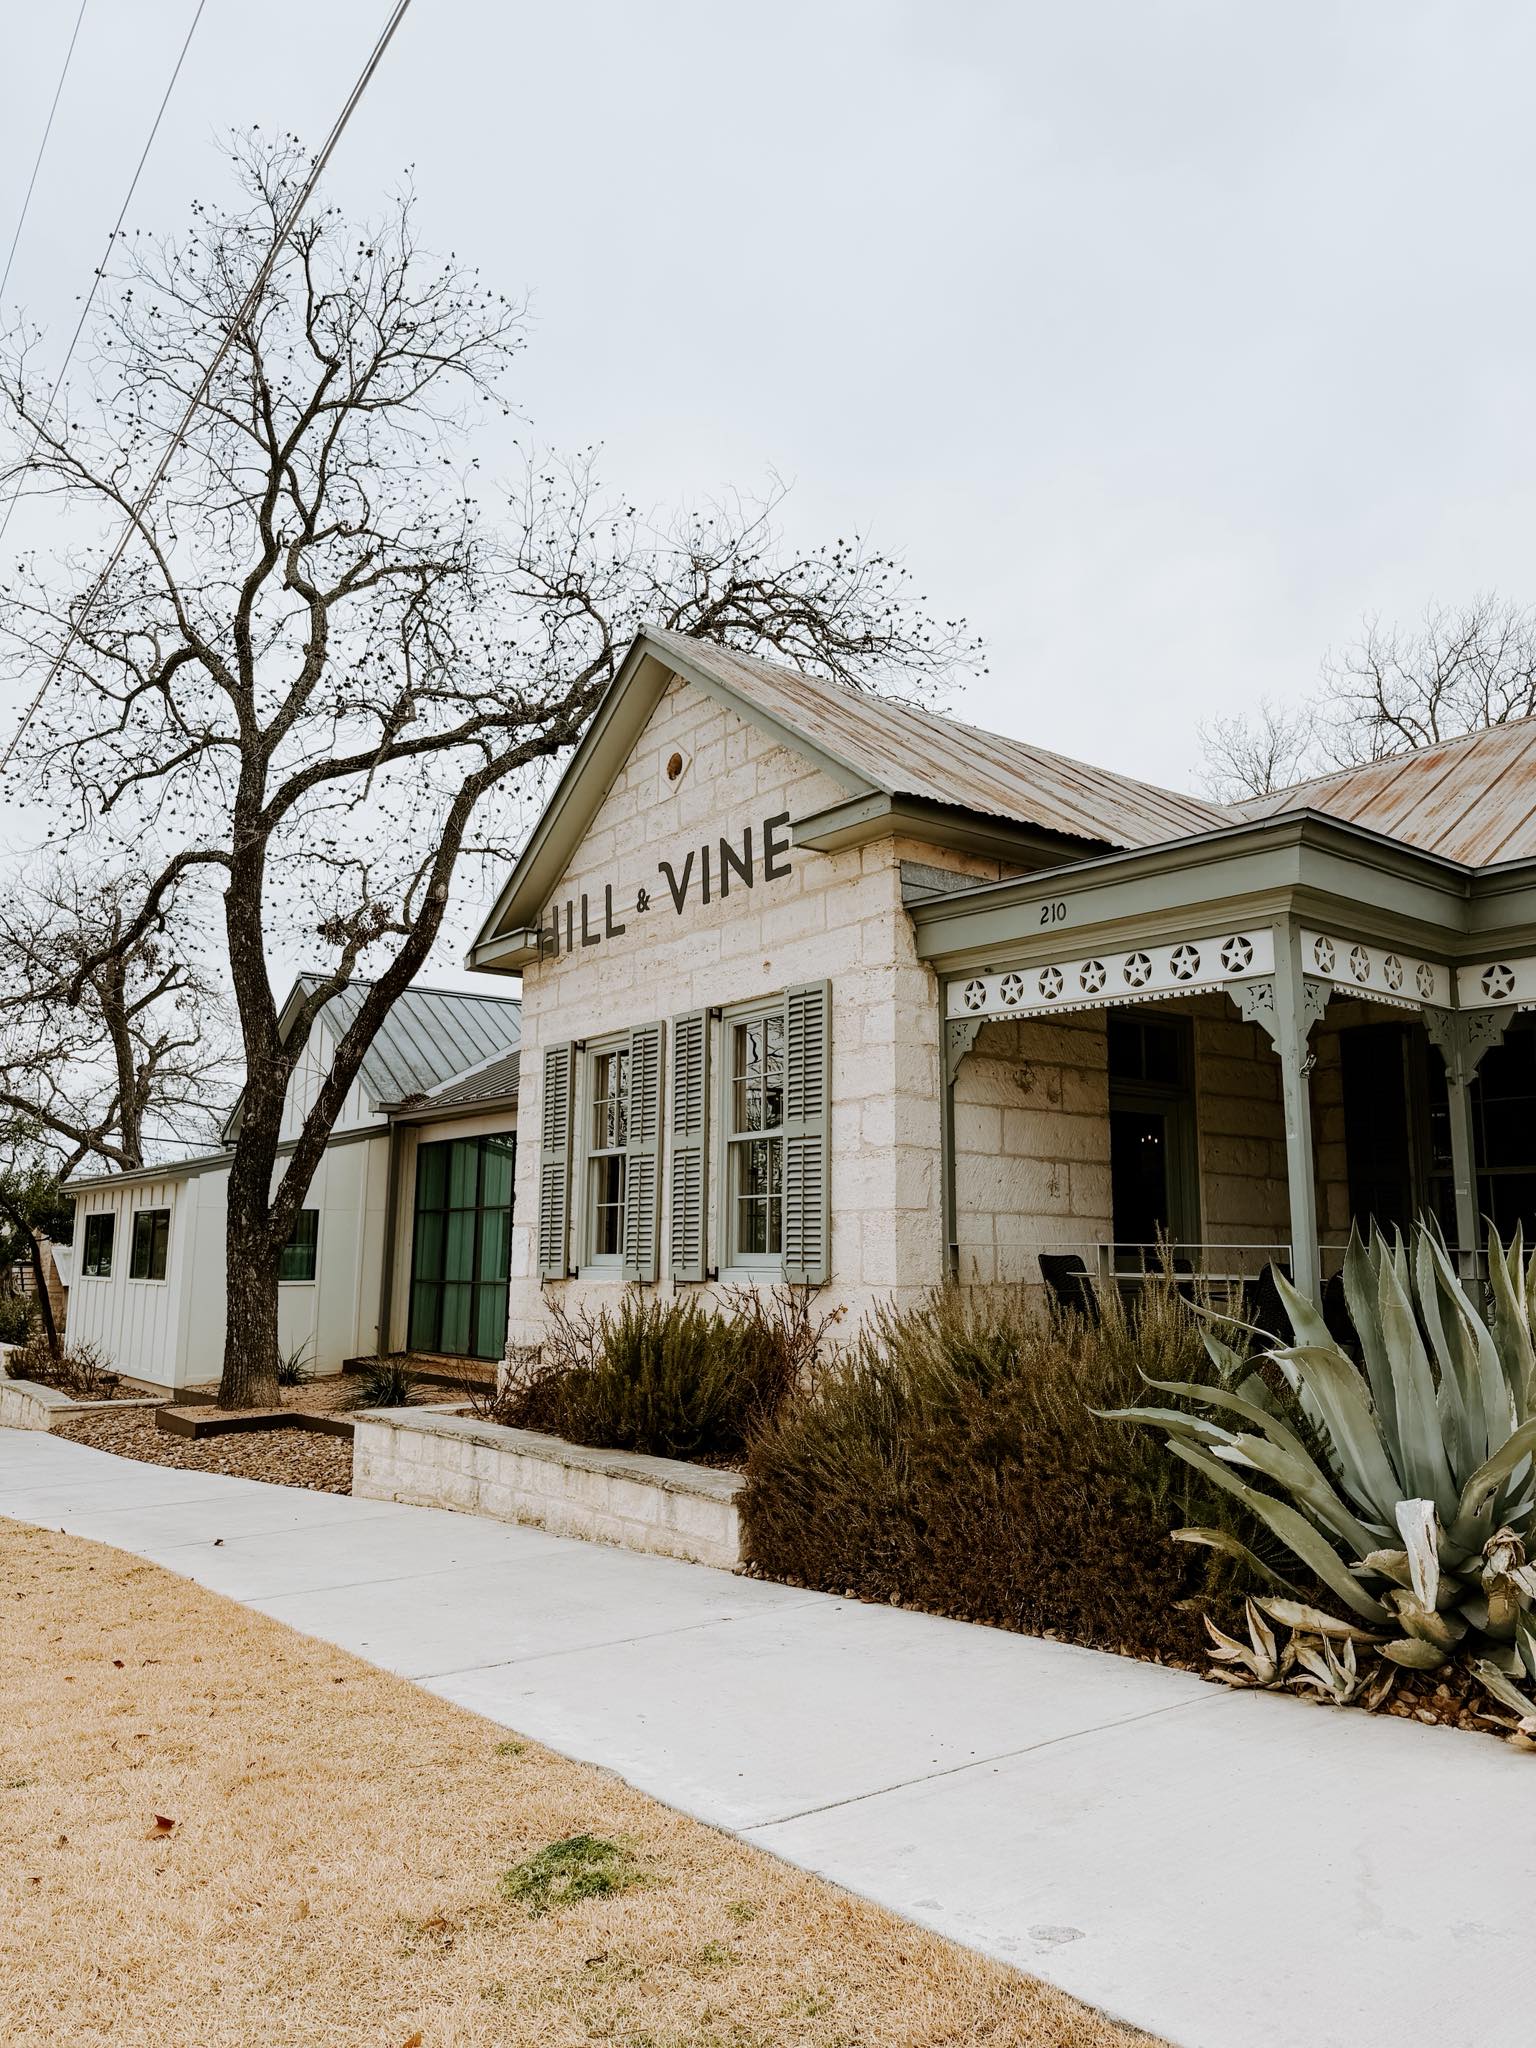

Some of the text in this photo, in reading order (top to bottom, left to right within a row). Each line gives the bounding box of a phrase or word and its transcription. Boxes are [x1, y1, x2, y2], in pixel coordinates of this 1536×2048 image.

[537, 811, 792, 962] HILL & VINE
[1040, 902, 1066, 925] 210
